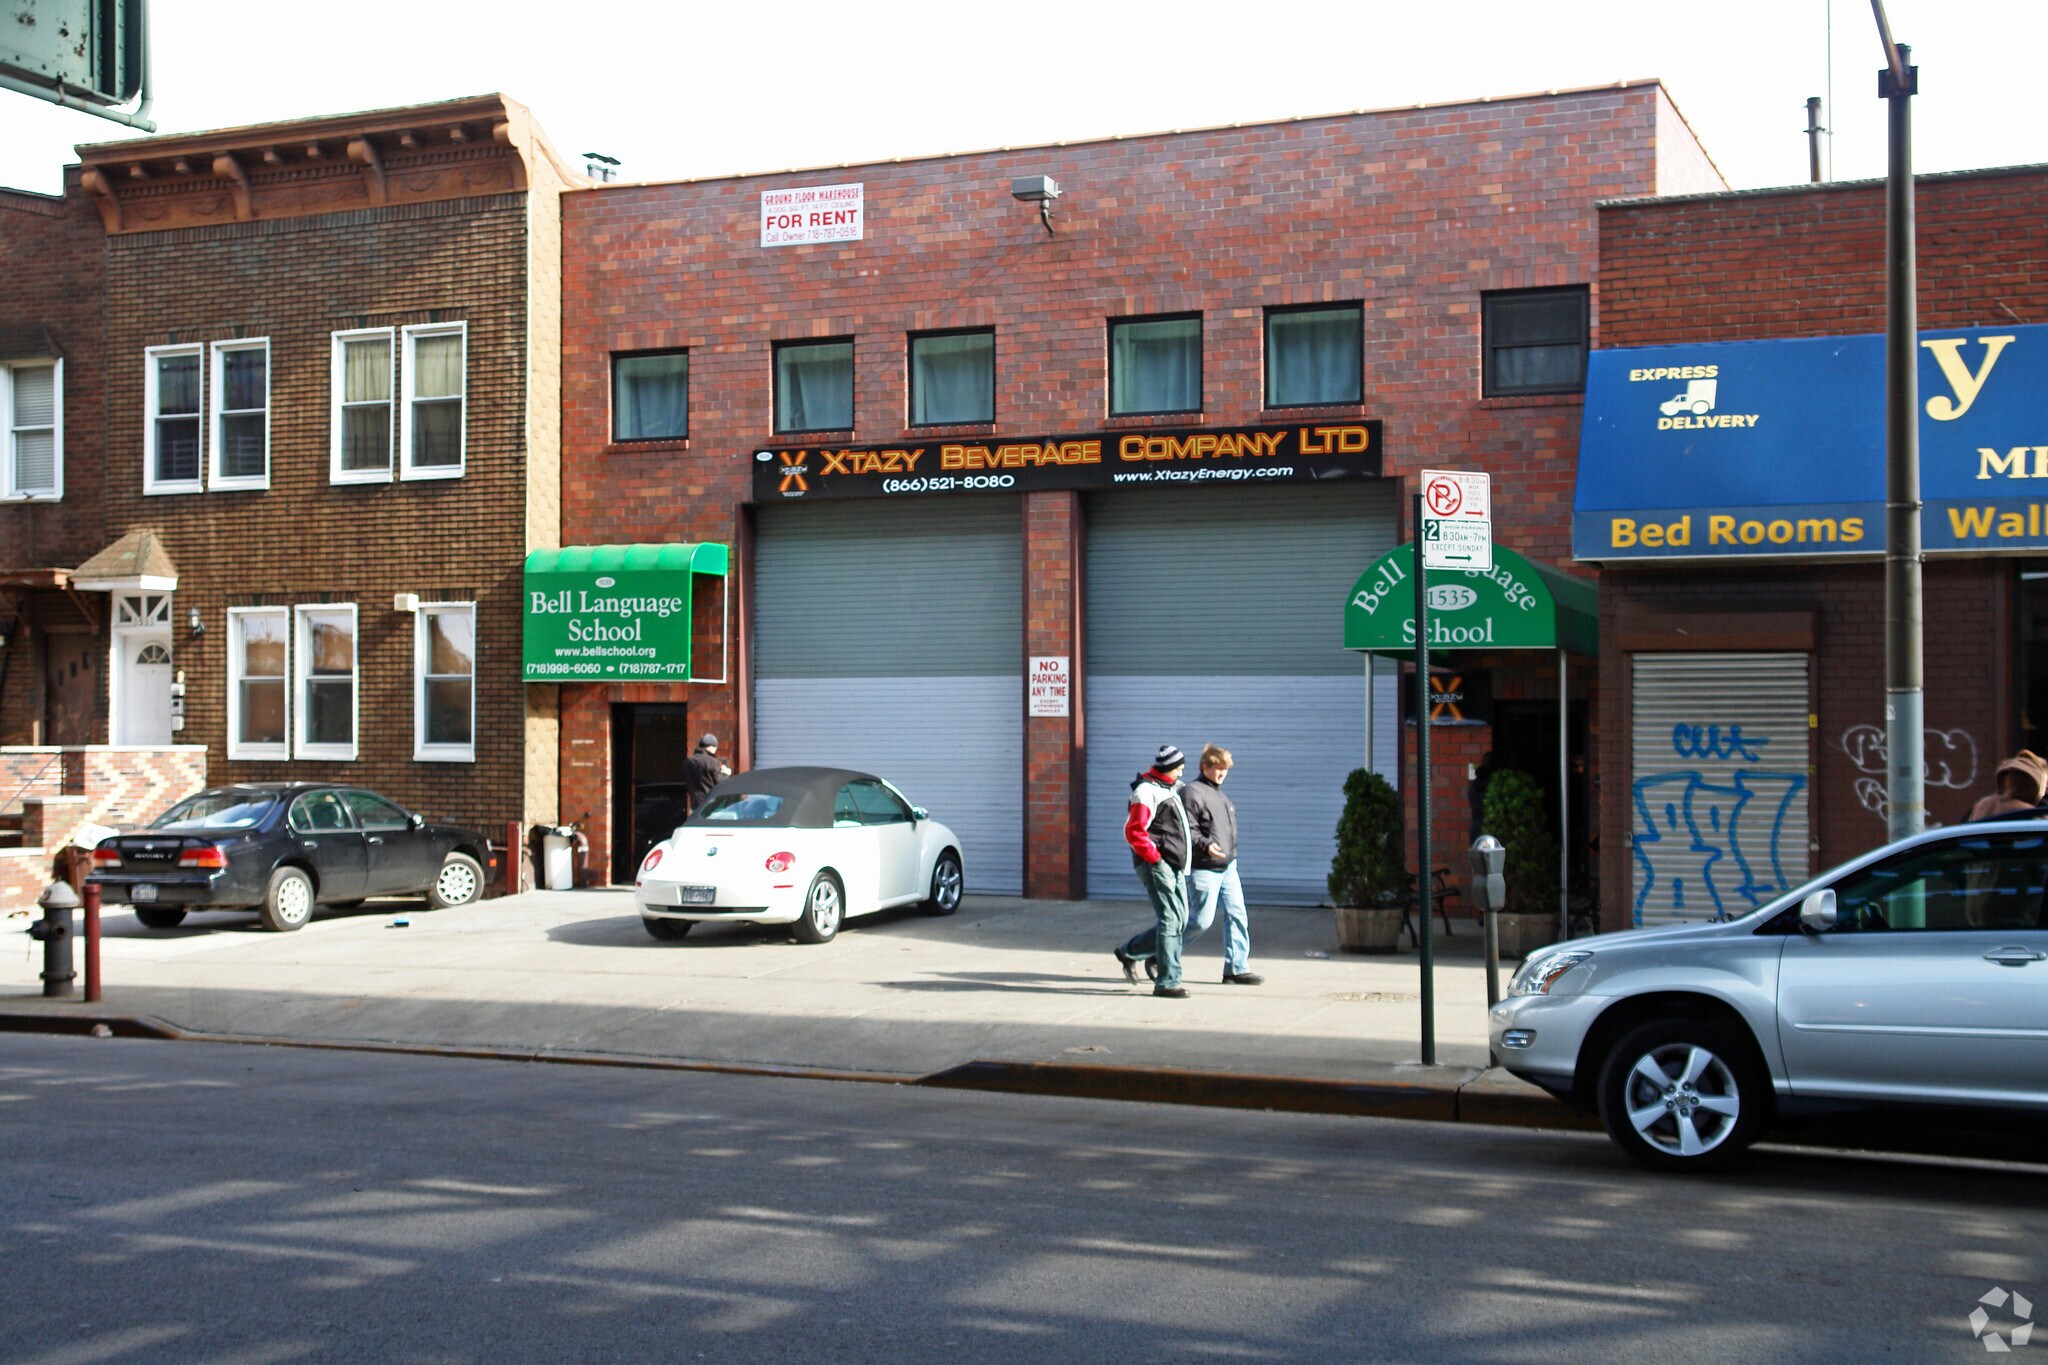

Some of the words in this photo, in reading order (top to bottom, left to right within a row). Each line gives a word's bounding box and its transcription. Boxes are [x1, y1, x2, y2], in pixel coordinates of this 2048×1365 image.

[765, 193, 792, 206] GROUND
[795, 191, 815, 203] FLOOR
[819, 187, 859, 200] WAREHOUSE
[766, 214, 802, 230] FOR
[810, 209, 857, 226] RENT
[1629, 365, 1719, 381] EXPRESS
[1657, 414, 1760, 430] DELIVERY
[819, 448, 924, 475] XTAZY
[940, 440, 1101, 470] BEVERAGE
[1119, 432, 1288, 461] COMPANY
[1300, 426, 1369, 455] LTD
[1113, 466, 1294, 483] www.XtazyEnergy.com
[882, 474, 1015, 493] (866)521-8080
[1427, 521, 1438, 540] 2
[1611, 515, 1691, 548] Bed
[1709, 515, 1865, 545] Rooms
[1431, 543, 1455, 551] EXCEPT
[1458, 544, 1484, 552] SUNDAY
[1352, 557, 1406, 615] Bell
[530, 590, 572, 614] Bell
[579, 591, 682, 617] Language
[1428, 590, 1470, 606] 1535
[568, 618, 642, 641] School
[554, 646, 656, 658] www.bellschool.org
[526, 663, 601, 674] (718)998-6060
[619, 663, 686, 674] (718)787-1717
[1039, 661, 1059, 671] NO
[1032, 674, 1067, 684] PARKING
[1032, 687, 1046, 696] ANY
[1050, 687, 1066, 696] TIME
